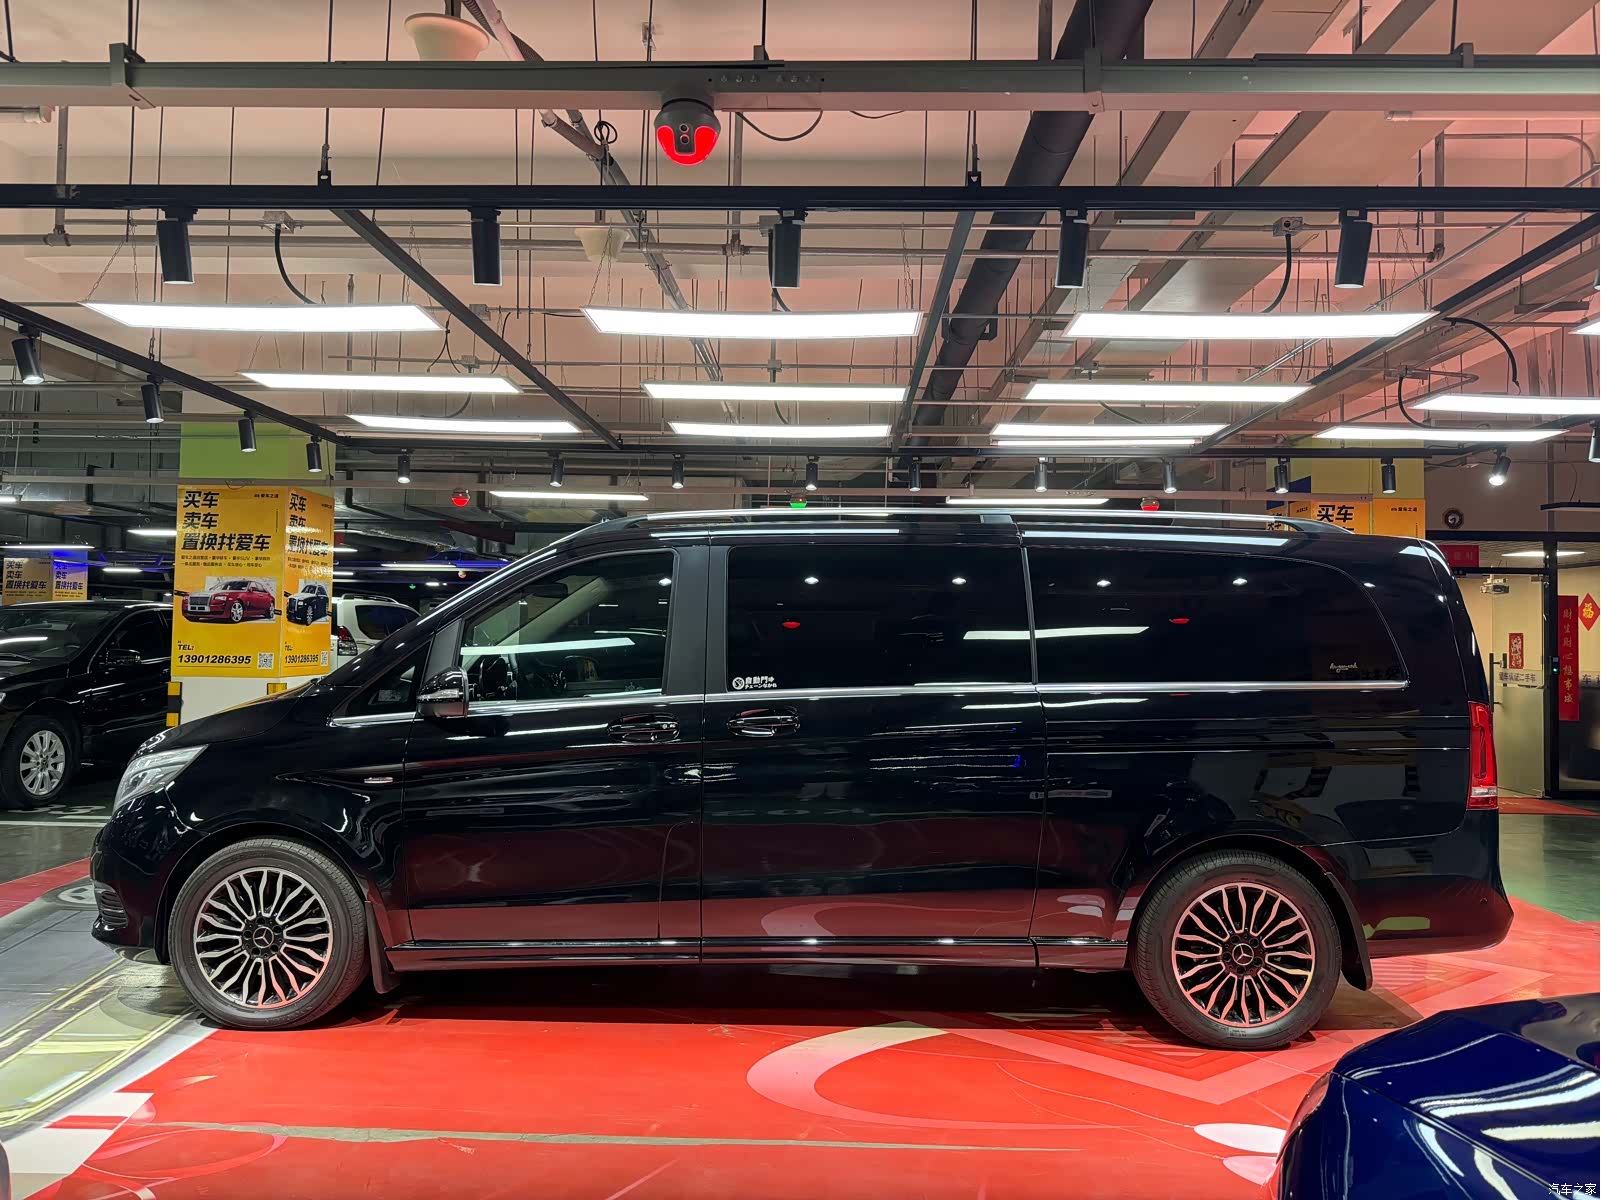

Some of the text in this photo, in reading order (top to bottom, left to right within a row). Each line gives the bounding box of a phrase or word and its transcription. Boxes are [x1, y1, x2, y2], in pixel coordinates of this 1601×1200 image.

[183, 491, 219, 508] 买车
[289, 493, 307, 512] 买车
[182, 512, 219, 529] 卖车
[1316, 504, 1354, 522] 买车
[181, 533, 271, 551] 置换找爱车
[177, 654, 251, 664] 13901286395
[284, 654, 319, 664] 13901286395
